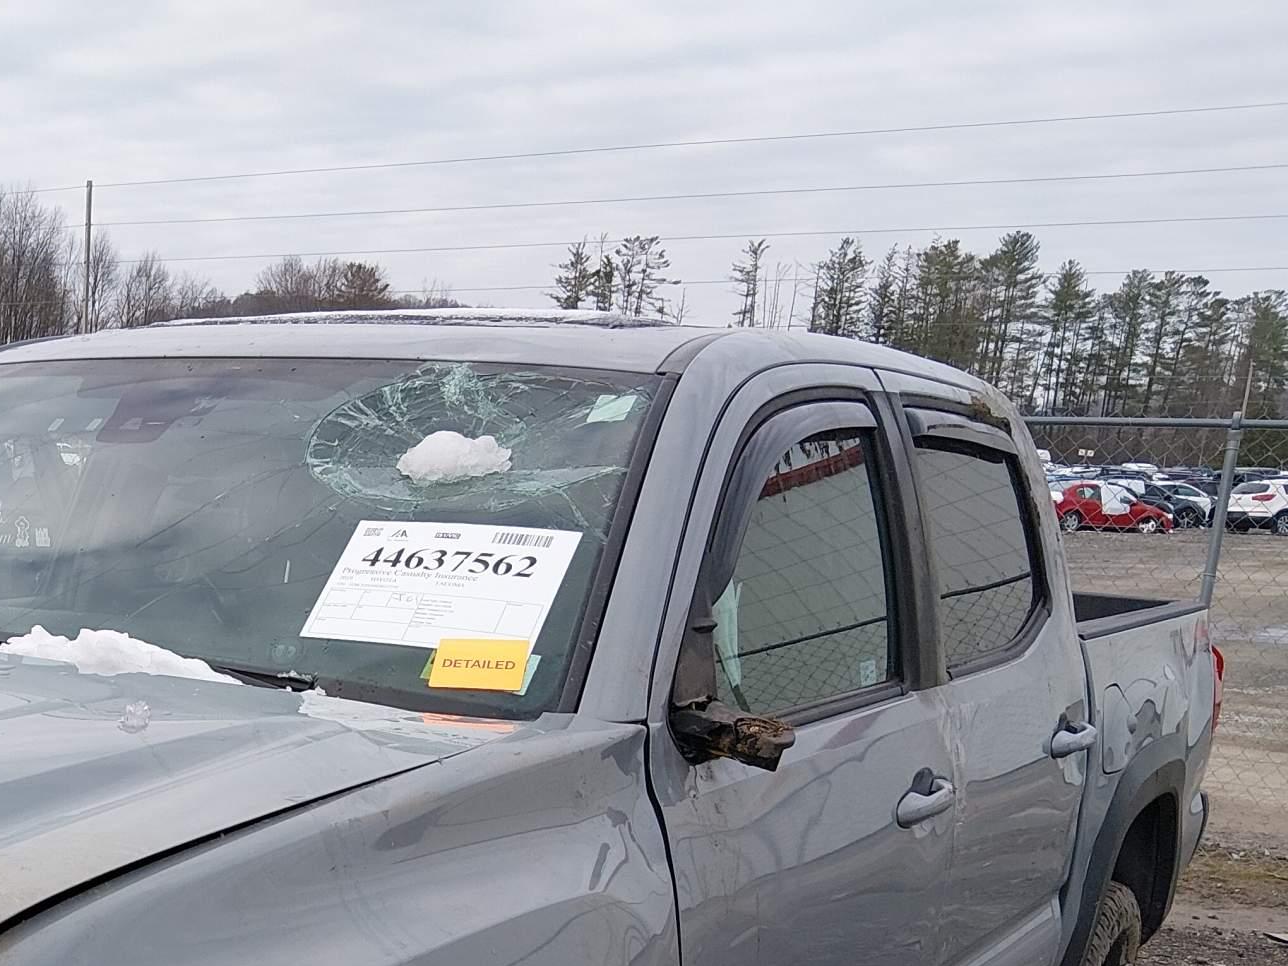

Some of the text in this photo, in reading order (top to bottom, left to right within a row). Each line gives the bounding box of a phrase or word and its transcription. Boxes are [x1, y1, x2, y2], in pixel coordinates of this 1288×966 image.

[361, 547, 538, 578] 44637562
[342, 567, 479, 582] Progressive Casualty Insurance
[441, 658, 516, 670] DETAILED
